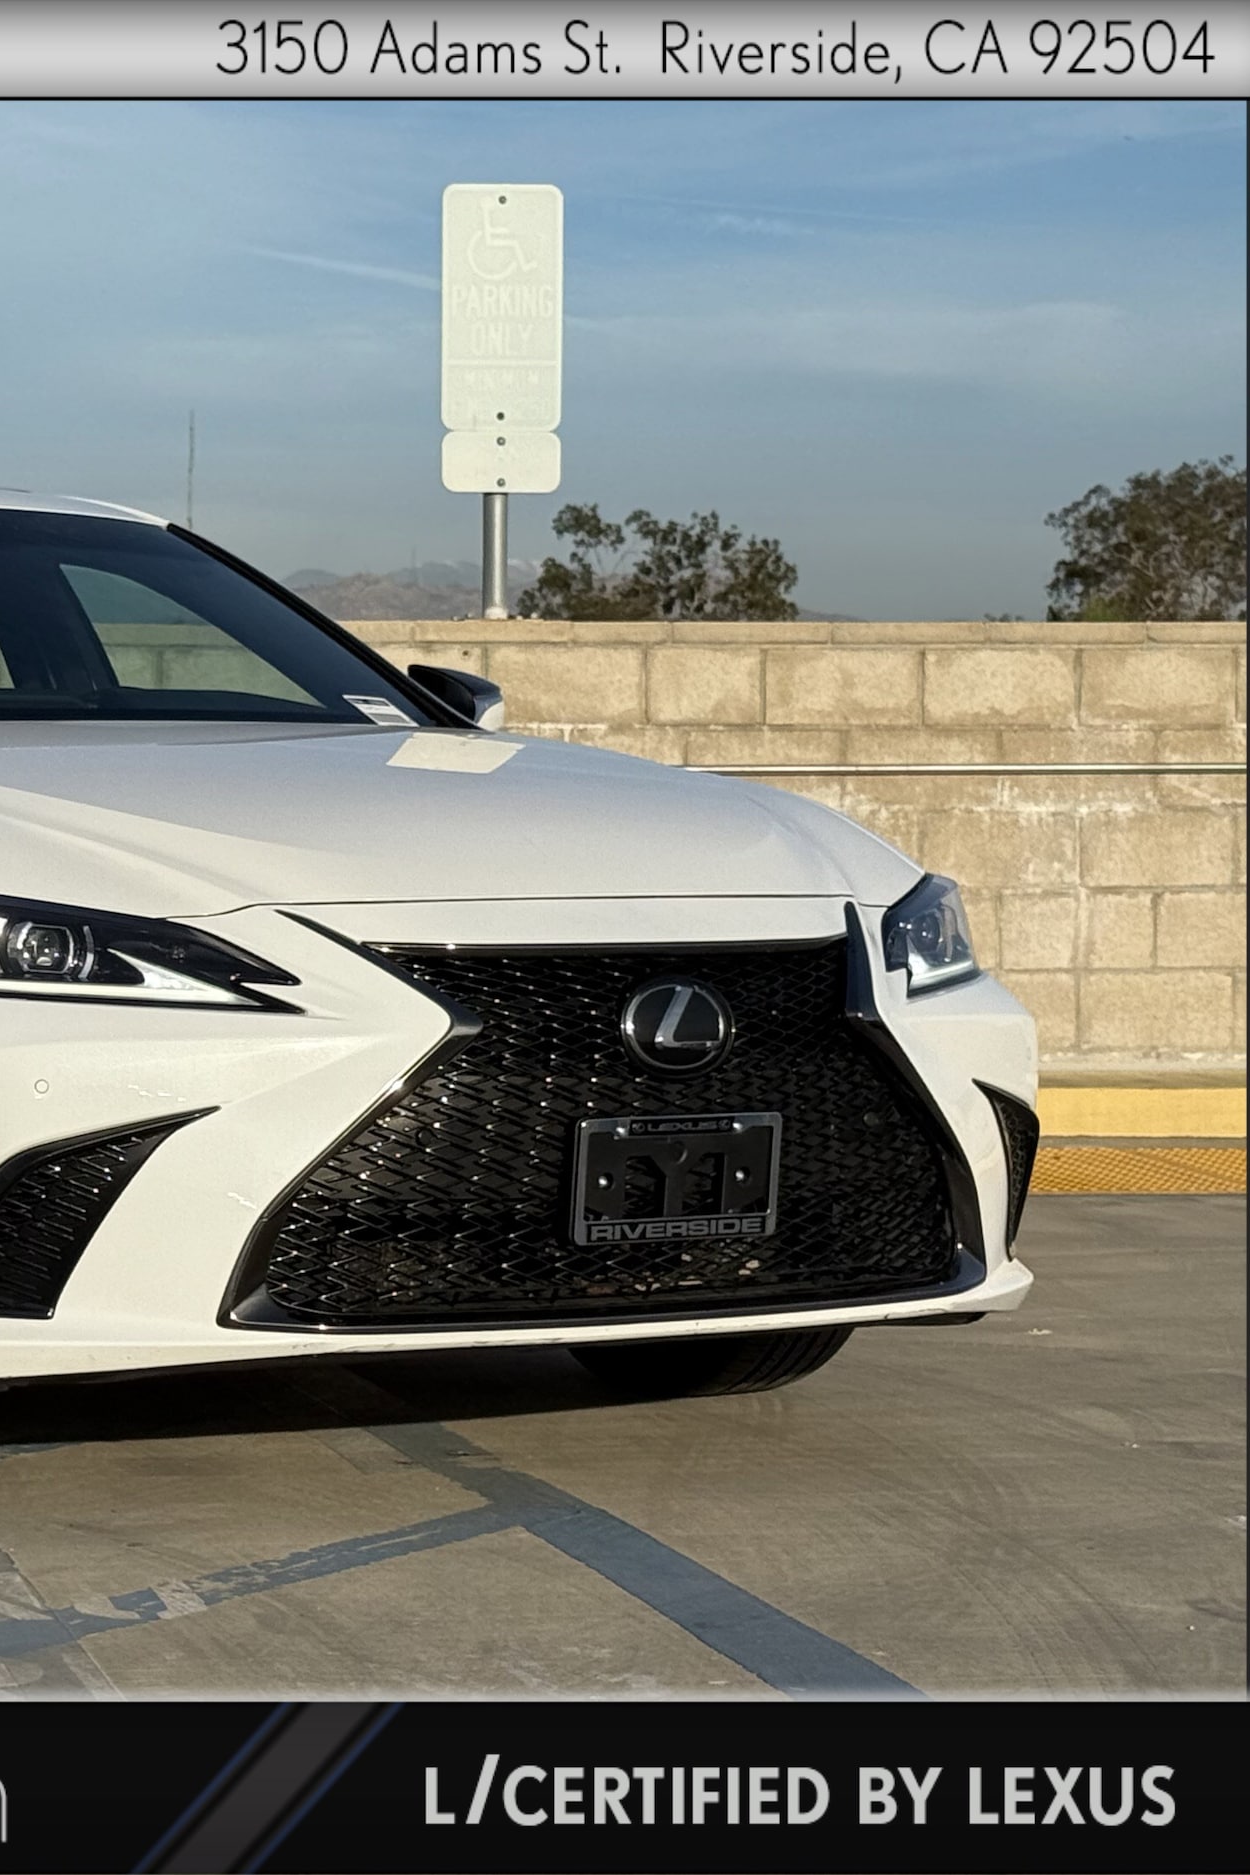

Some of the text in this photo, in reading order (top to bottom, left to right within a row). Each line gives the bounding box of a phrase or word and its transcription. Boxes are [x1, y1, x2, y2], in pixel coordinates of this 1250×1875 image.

[452, 284, 553, 318] PARKING
[470, 322, 533, 356] ONLY
[647, 1120, 718, 1132] LEXUS
[590, 1217, 762, 1242] RIVERSIDE
